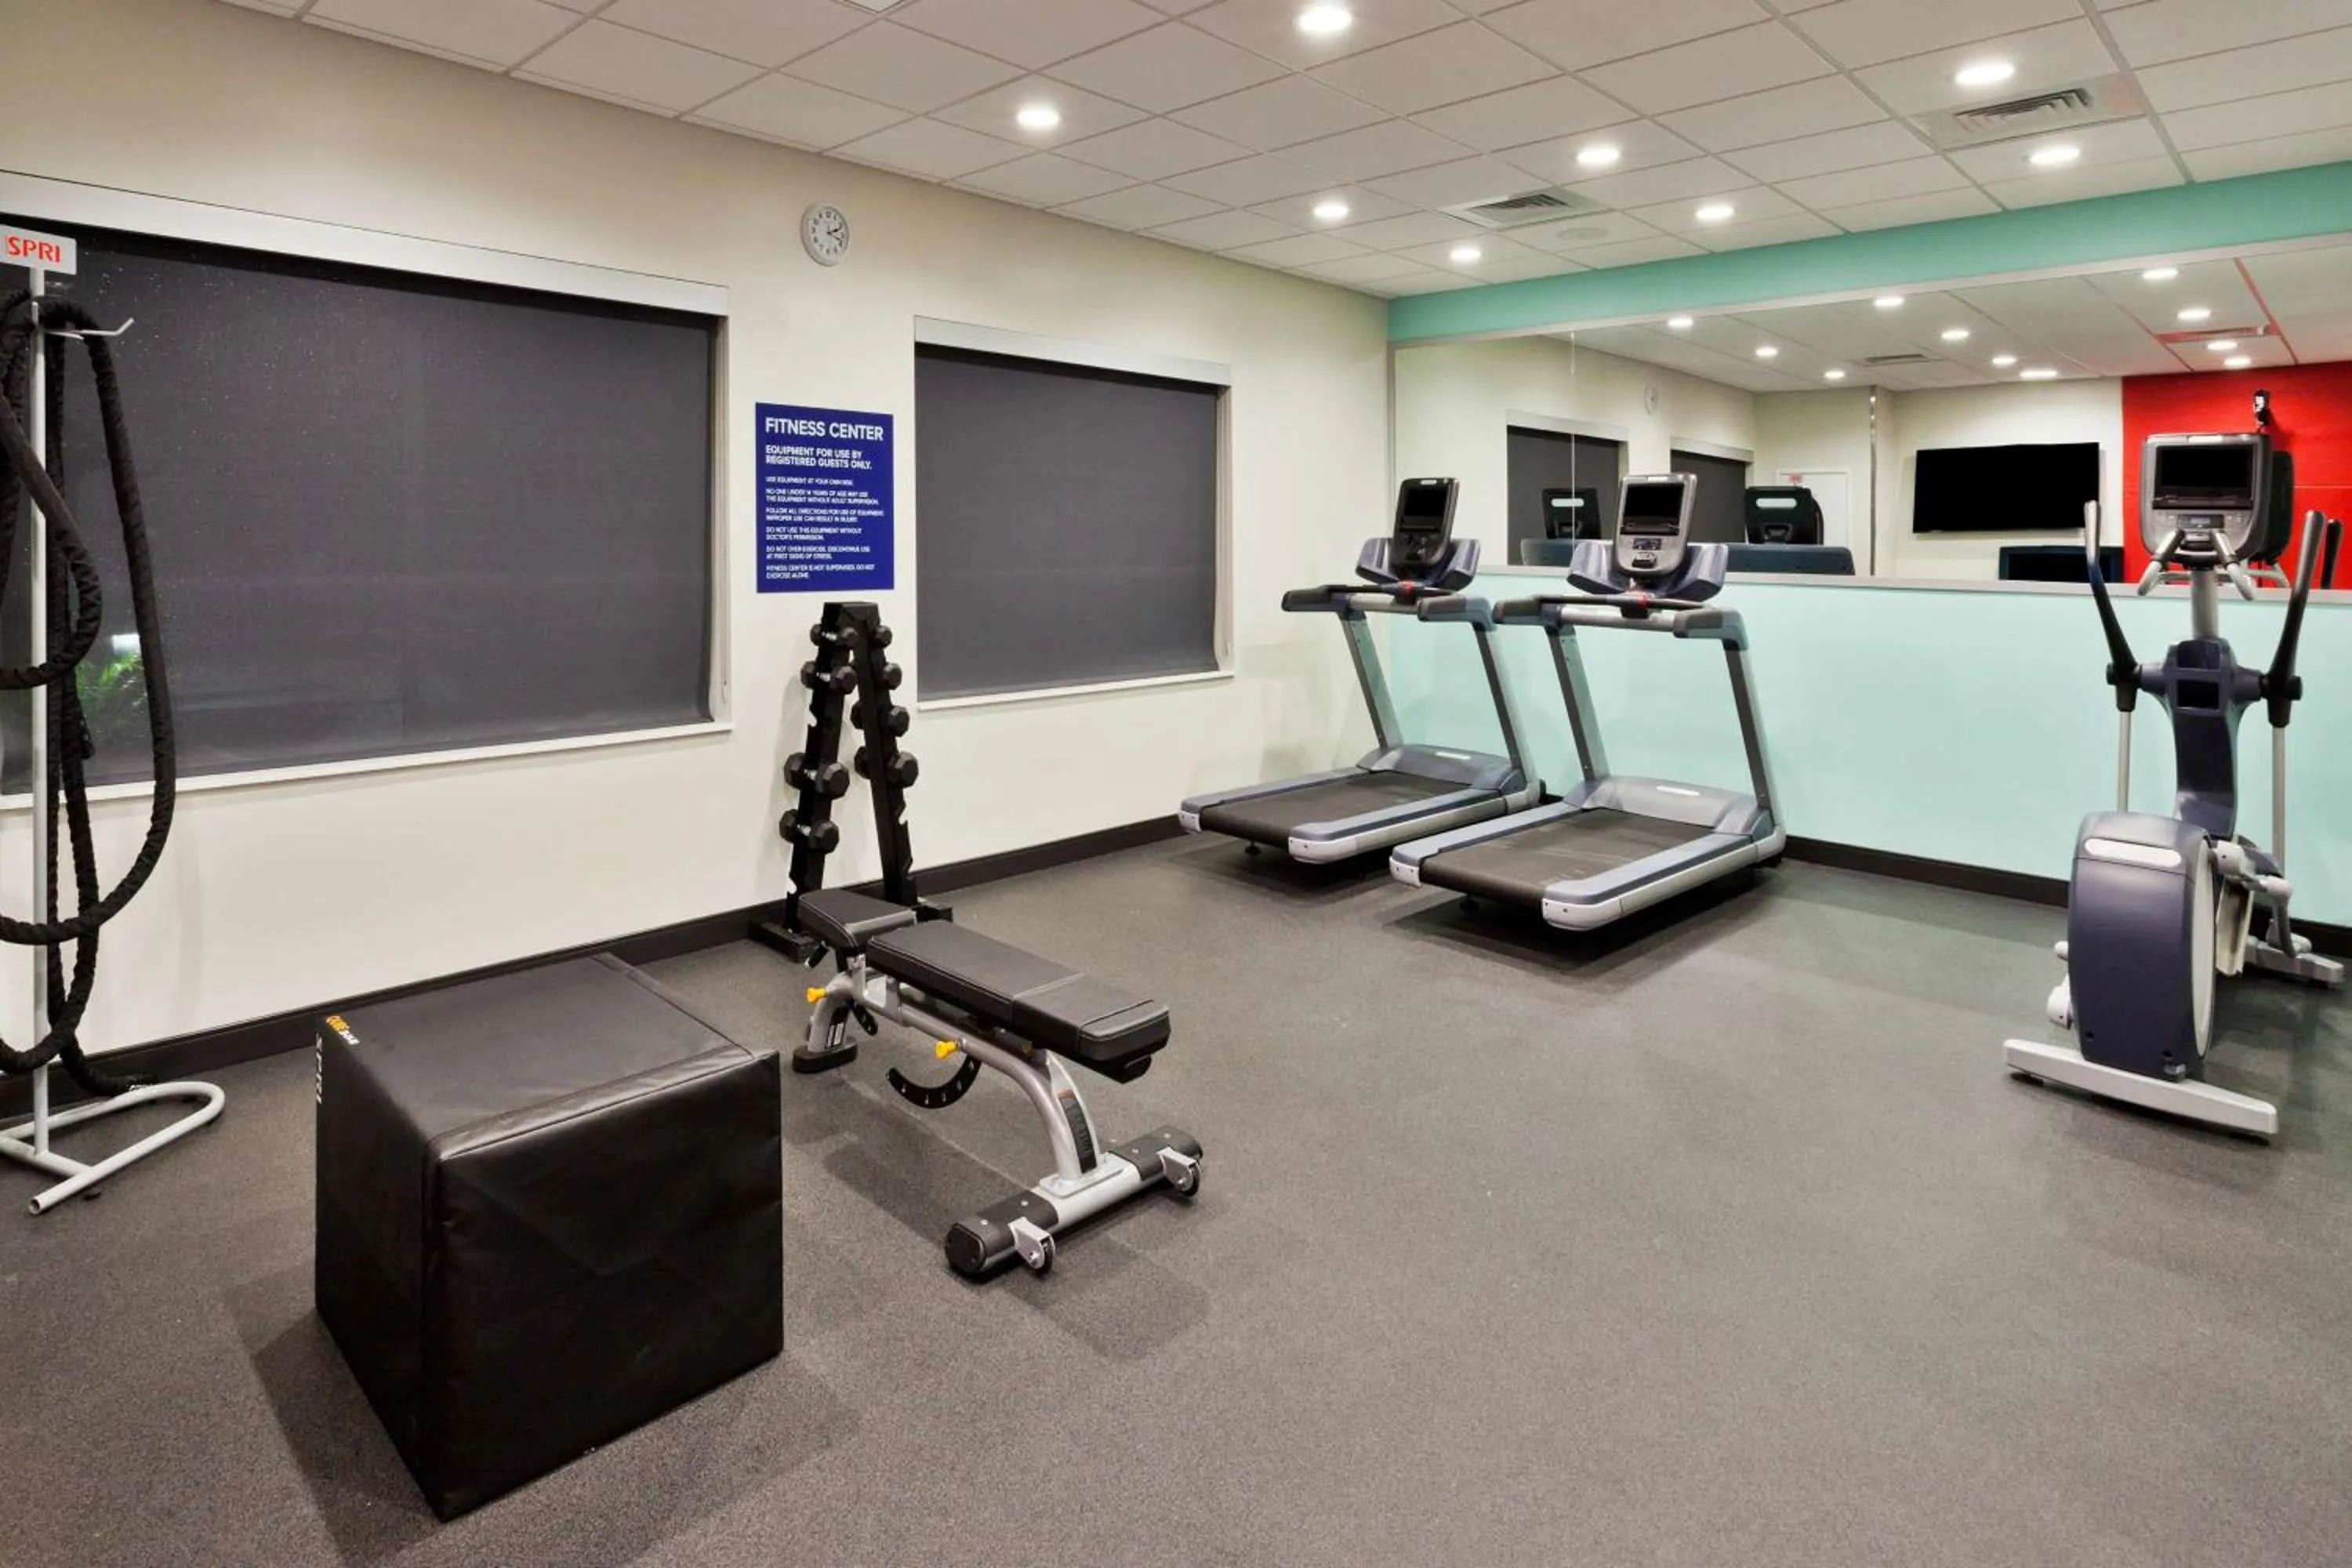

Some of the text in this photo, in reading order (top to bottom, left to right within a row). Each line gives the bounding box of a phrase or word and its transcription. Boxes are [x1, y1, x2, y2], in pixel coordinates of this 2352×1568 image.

[9, 236, 60, 263] SPRI
[765, 417, 883, 441] FITNESS CENTER
[766, 445, 862, 459] EQUIPMENT FOR USE BY
[766, 454, 872, 469] REGISTERED GUESTS ONLY.
